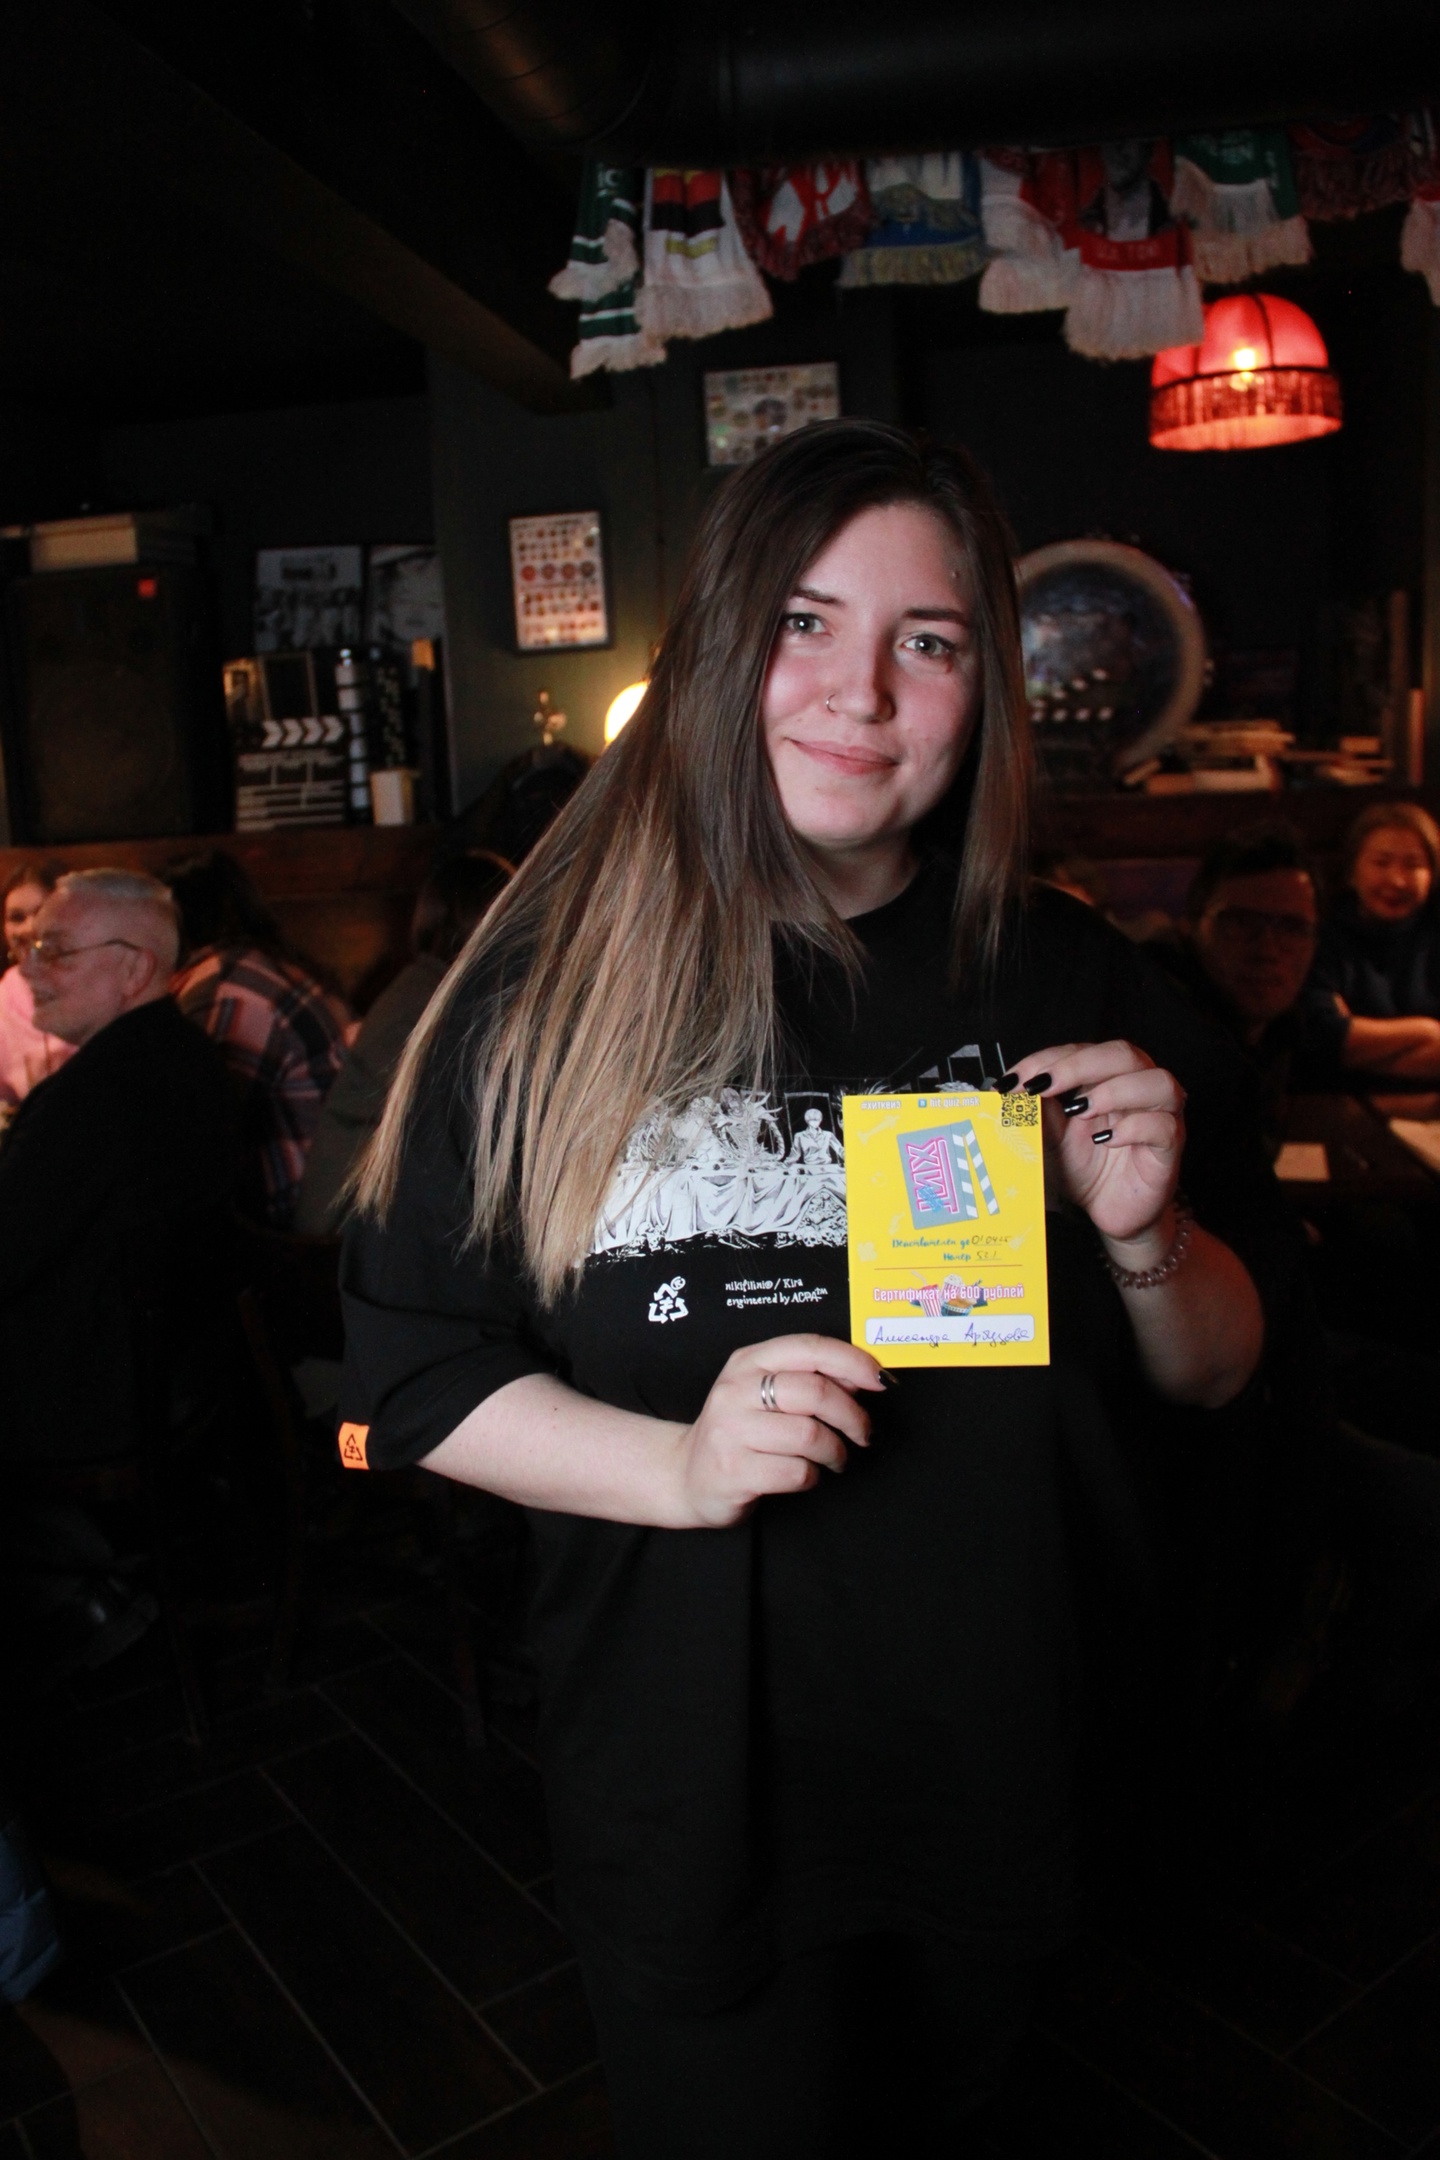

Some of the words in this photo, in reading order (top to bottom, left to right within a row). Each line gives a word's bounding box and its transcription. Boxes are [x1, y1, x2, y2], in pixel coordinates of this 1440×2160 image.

[782, 1278, 804, 1289] Kira
[726, 1293, 778, 1309] engineered
[779, 1292, 790, 1306] by
[873, 1286, 941, 1303] Сертификат
[943, 1287, 957, 1300] на
[960, 1286, 980, 1300] 600
[983, 1283, 1025, 1301] рублей
[873, 1325, 951, 1348] Александра
